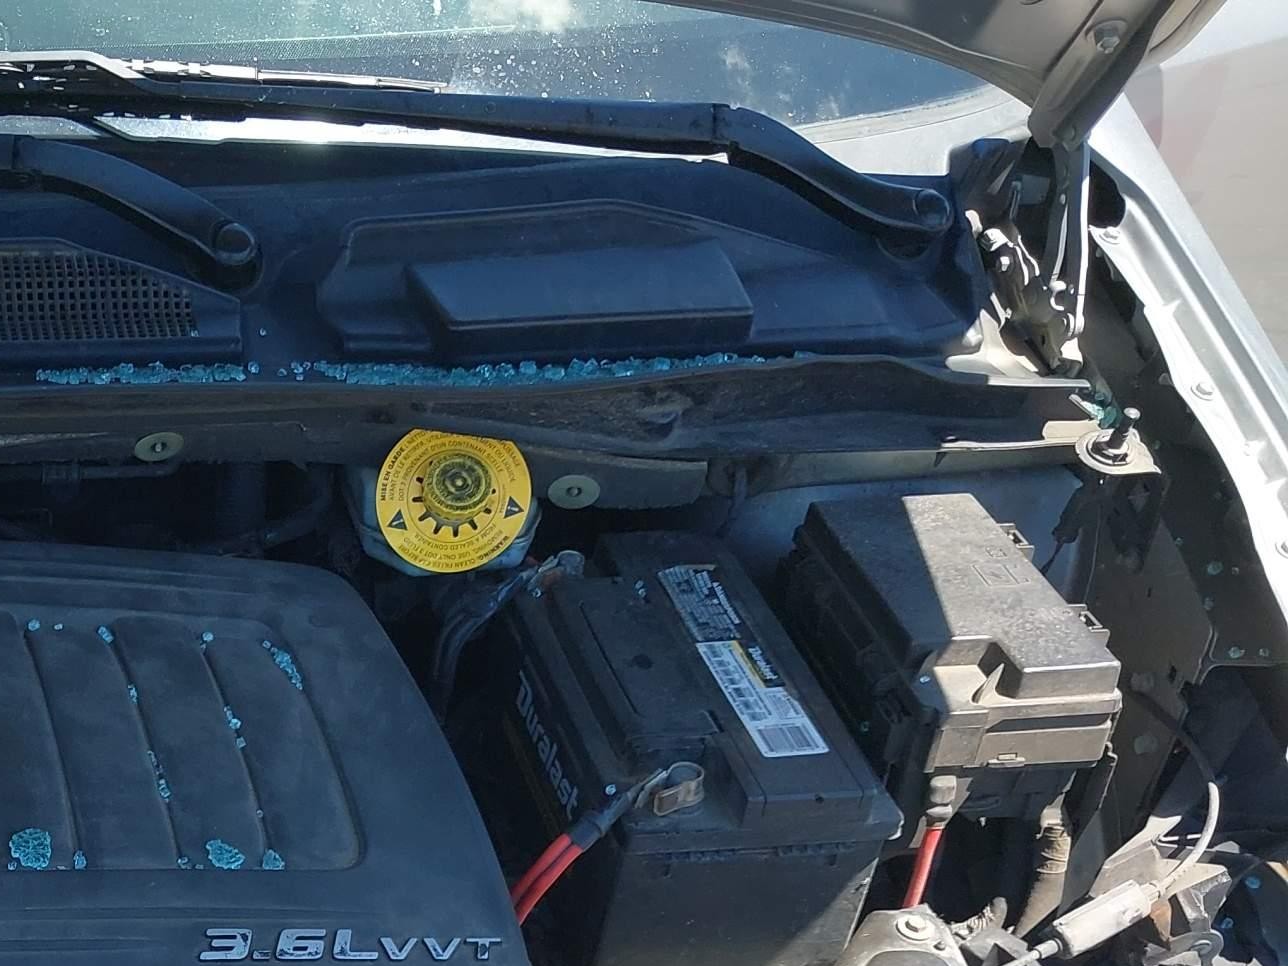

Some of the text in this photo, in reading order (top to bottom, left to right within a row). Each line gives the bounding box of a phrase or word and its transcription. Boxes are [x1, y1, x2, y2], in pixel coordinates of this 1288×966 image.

[382, 469, 390, 481] EN
[389, 478, 397, 501] AVANT
[516, 670, 579, 821] Duralast
